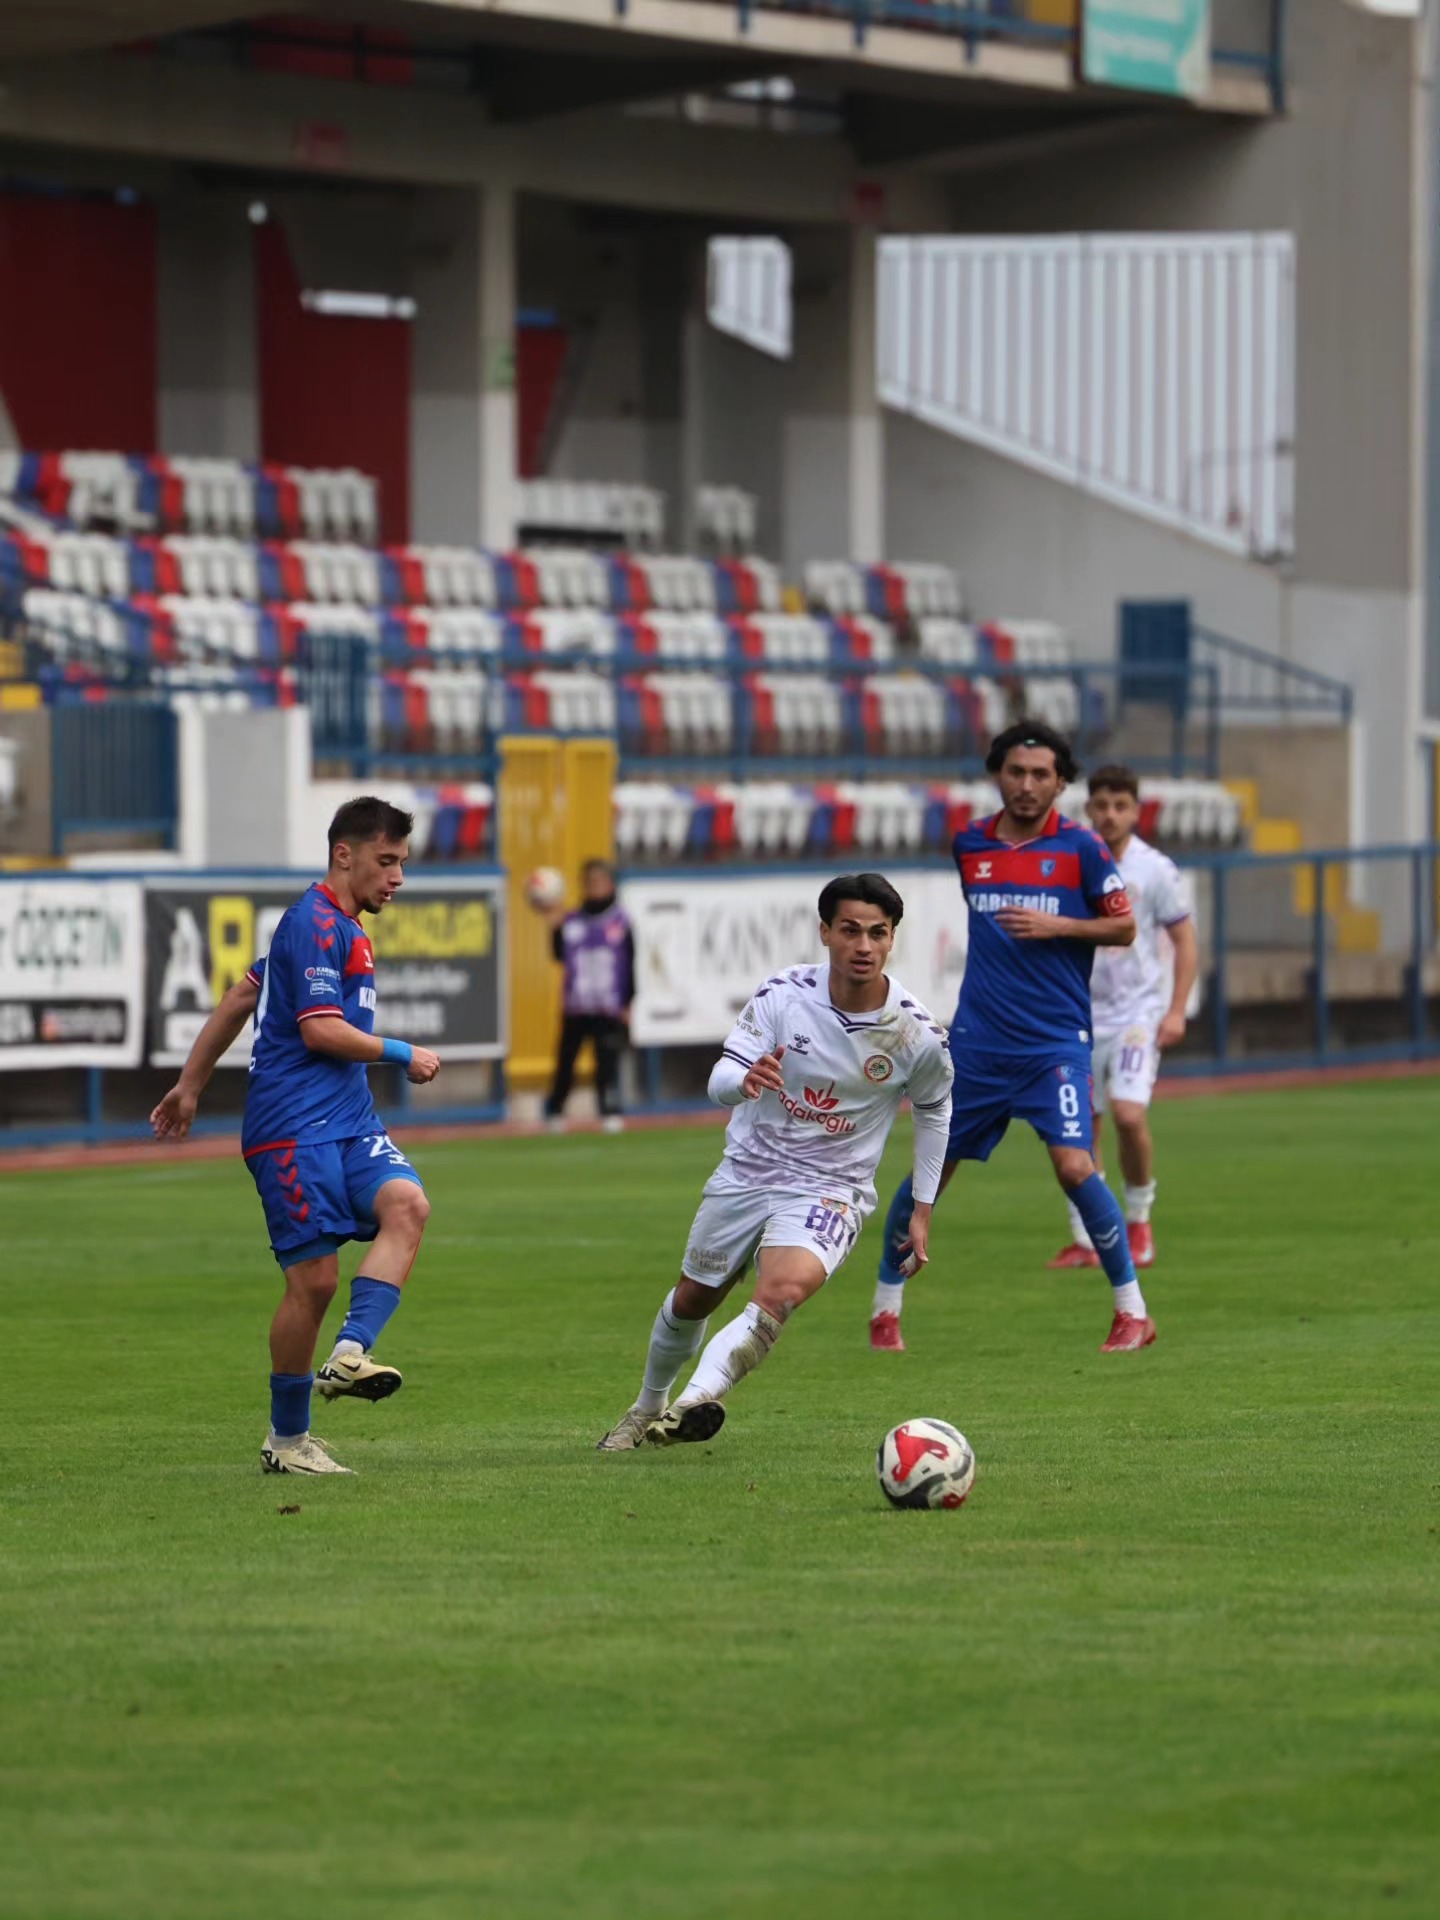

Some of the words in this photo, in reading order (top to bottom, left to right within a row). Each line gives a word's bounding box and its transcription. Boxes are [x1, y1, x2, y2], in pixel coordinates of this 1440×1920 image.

[1120, 1046, 1144, 1073] 10
[1059, 1084, 1079, 1117] 8
[804, 1204, 846, 1248] 80
